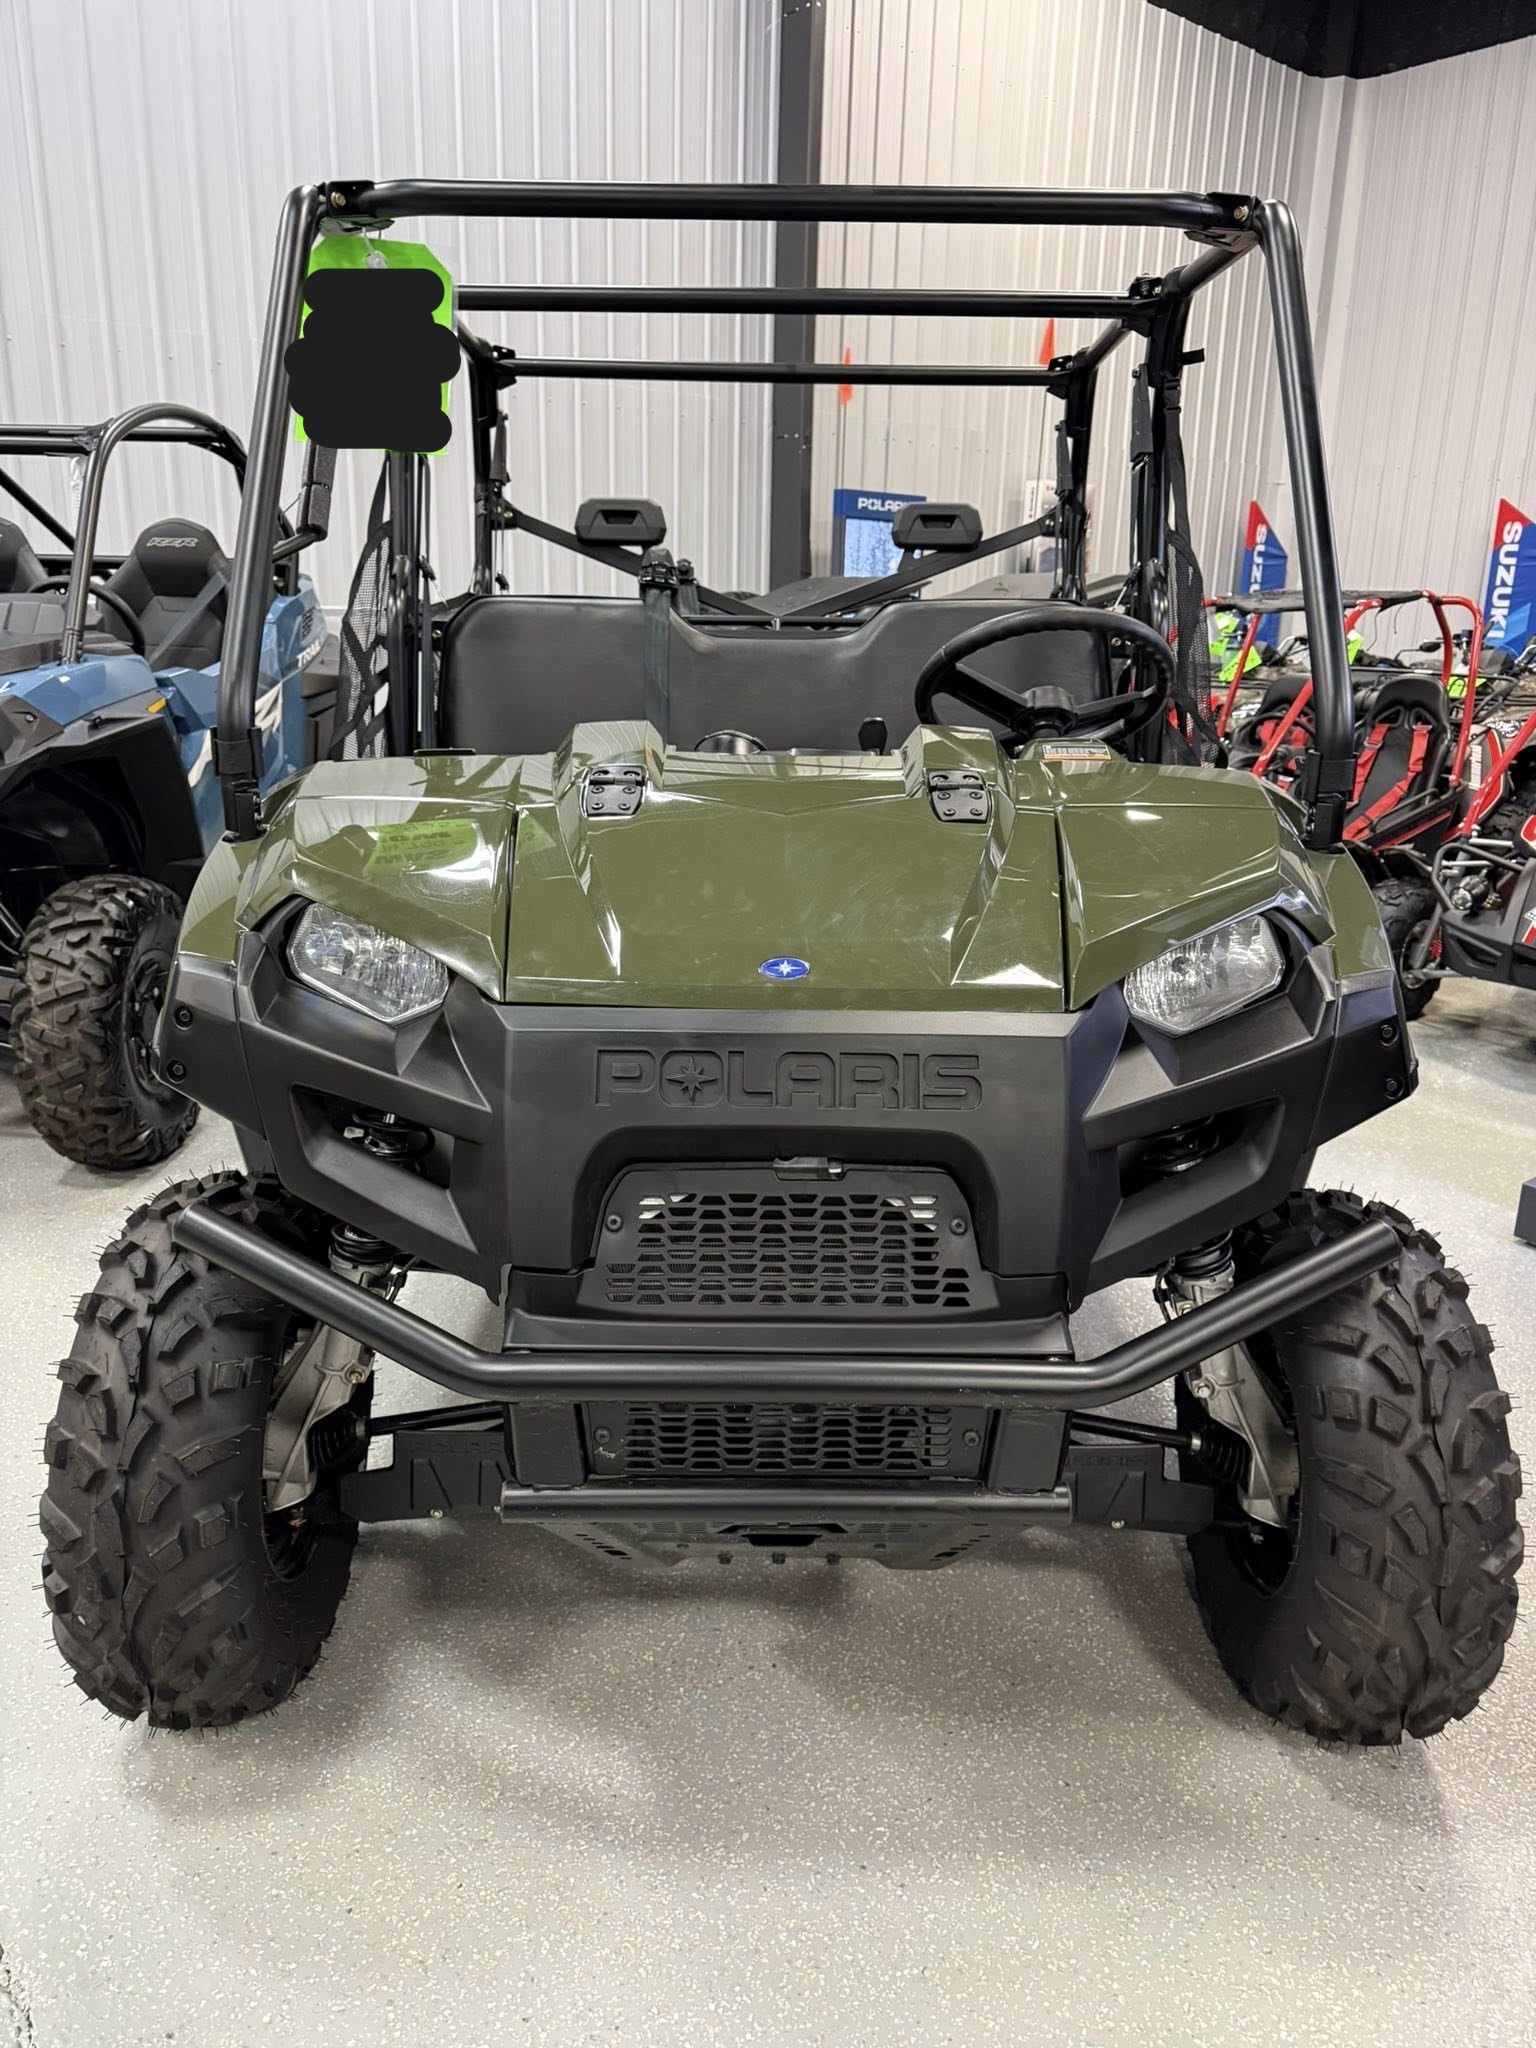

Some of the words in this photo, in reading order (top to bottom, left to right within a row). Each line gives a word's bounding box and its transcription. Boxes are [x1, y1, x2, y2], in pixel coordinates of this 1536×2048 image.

[146, 536, 199, 547] RZR
[1487, 521, 1523, 639] SUZUKI
[596, 1048, 982, 1110] POLARIS
